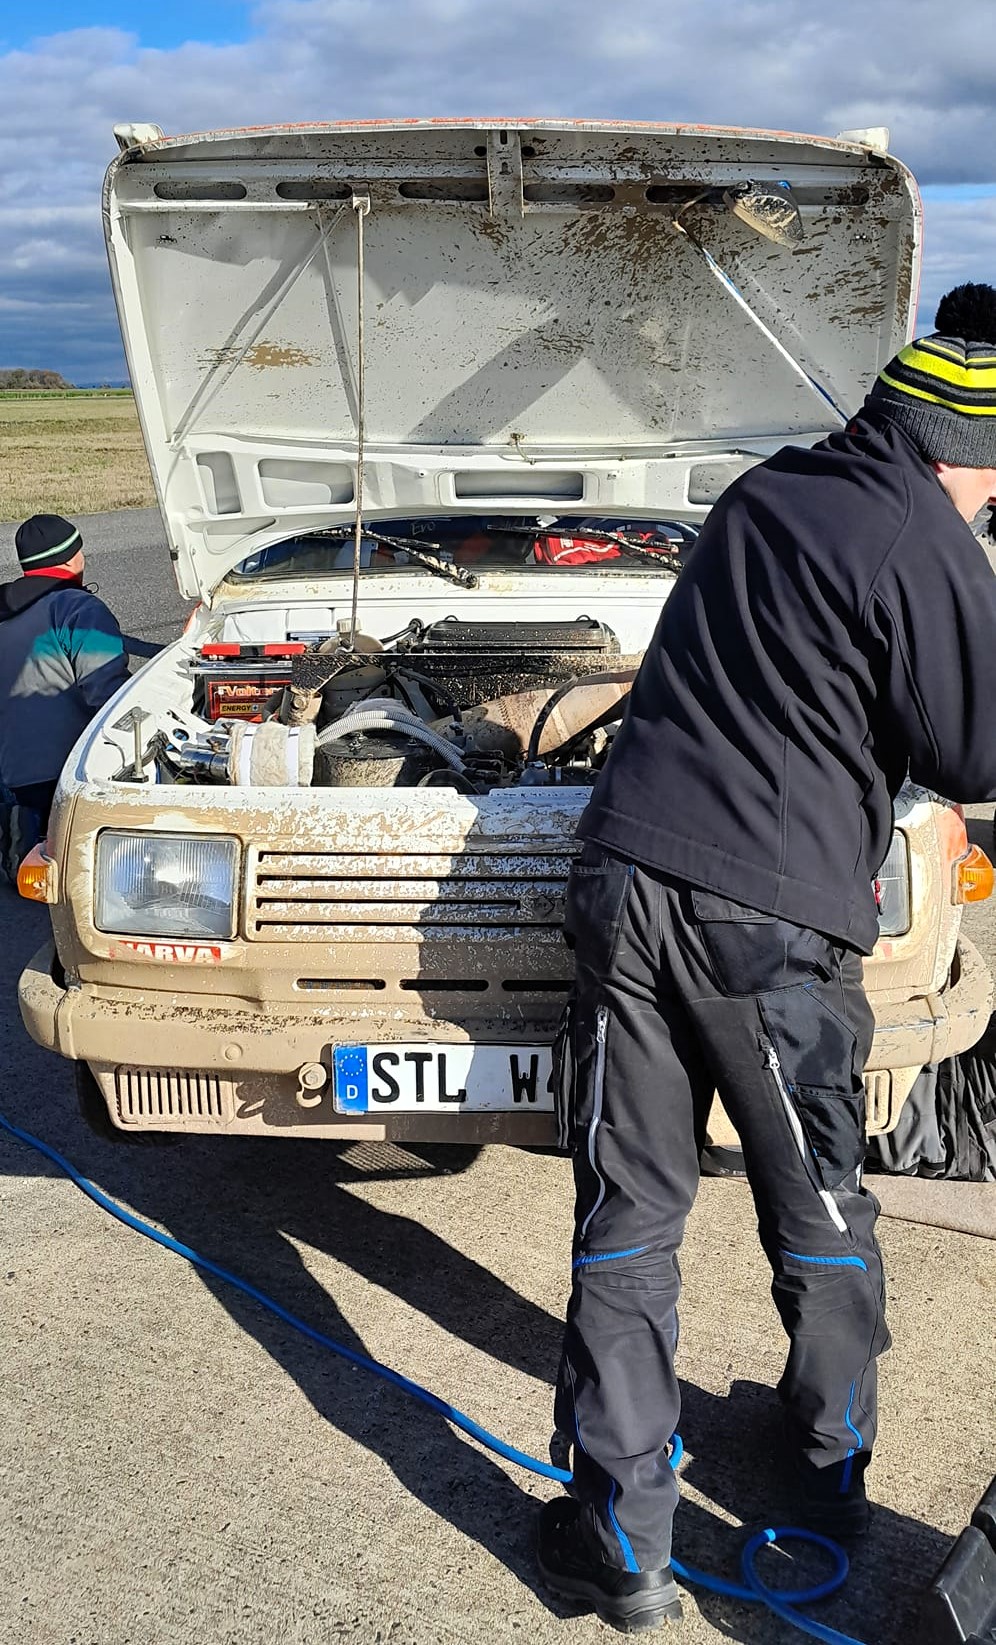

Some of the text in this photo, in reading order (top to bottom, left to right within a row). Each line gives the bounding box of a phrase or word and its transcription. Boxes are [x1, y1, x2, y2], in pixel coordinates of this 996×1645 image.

[123, 942, 216, 964] ARVA
[371, 1052, 467, 1103] STL
[346, 1084, 359, 1100] D
